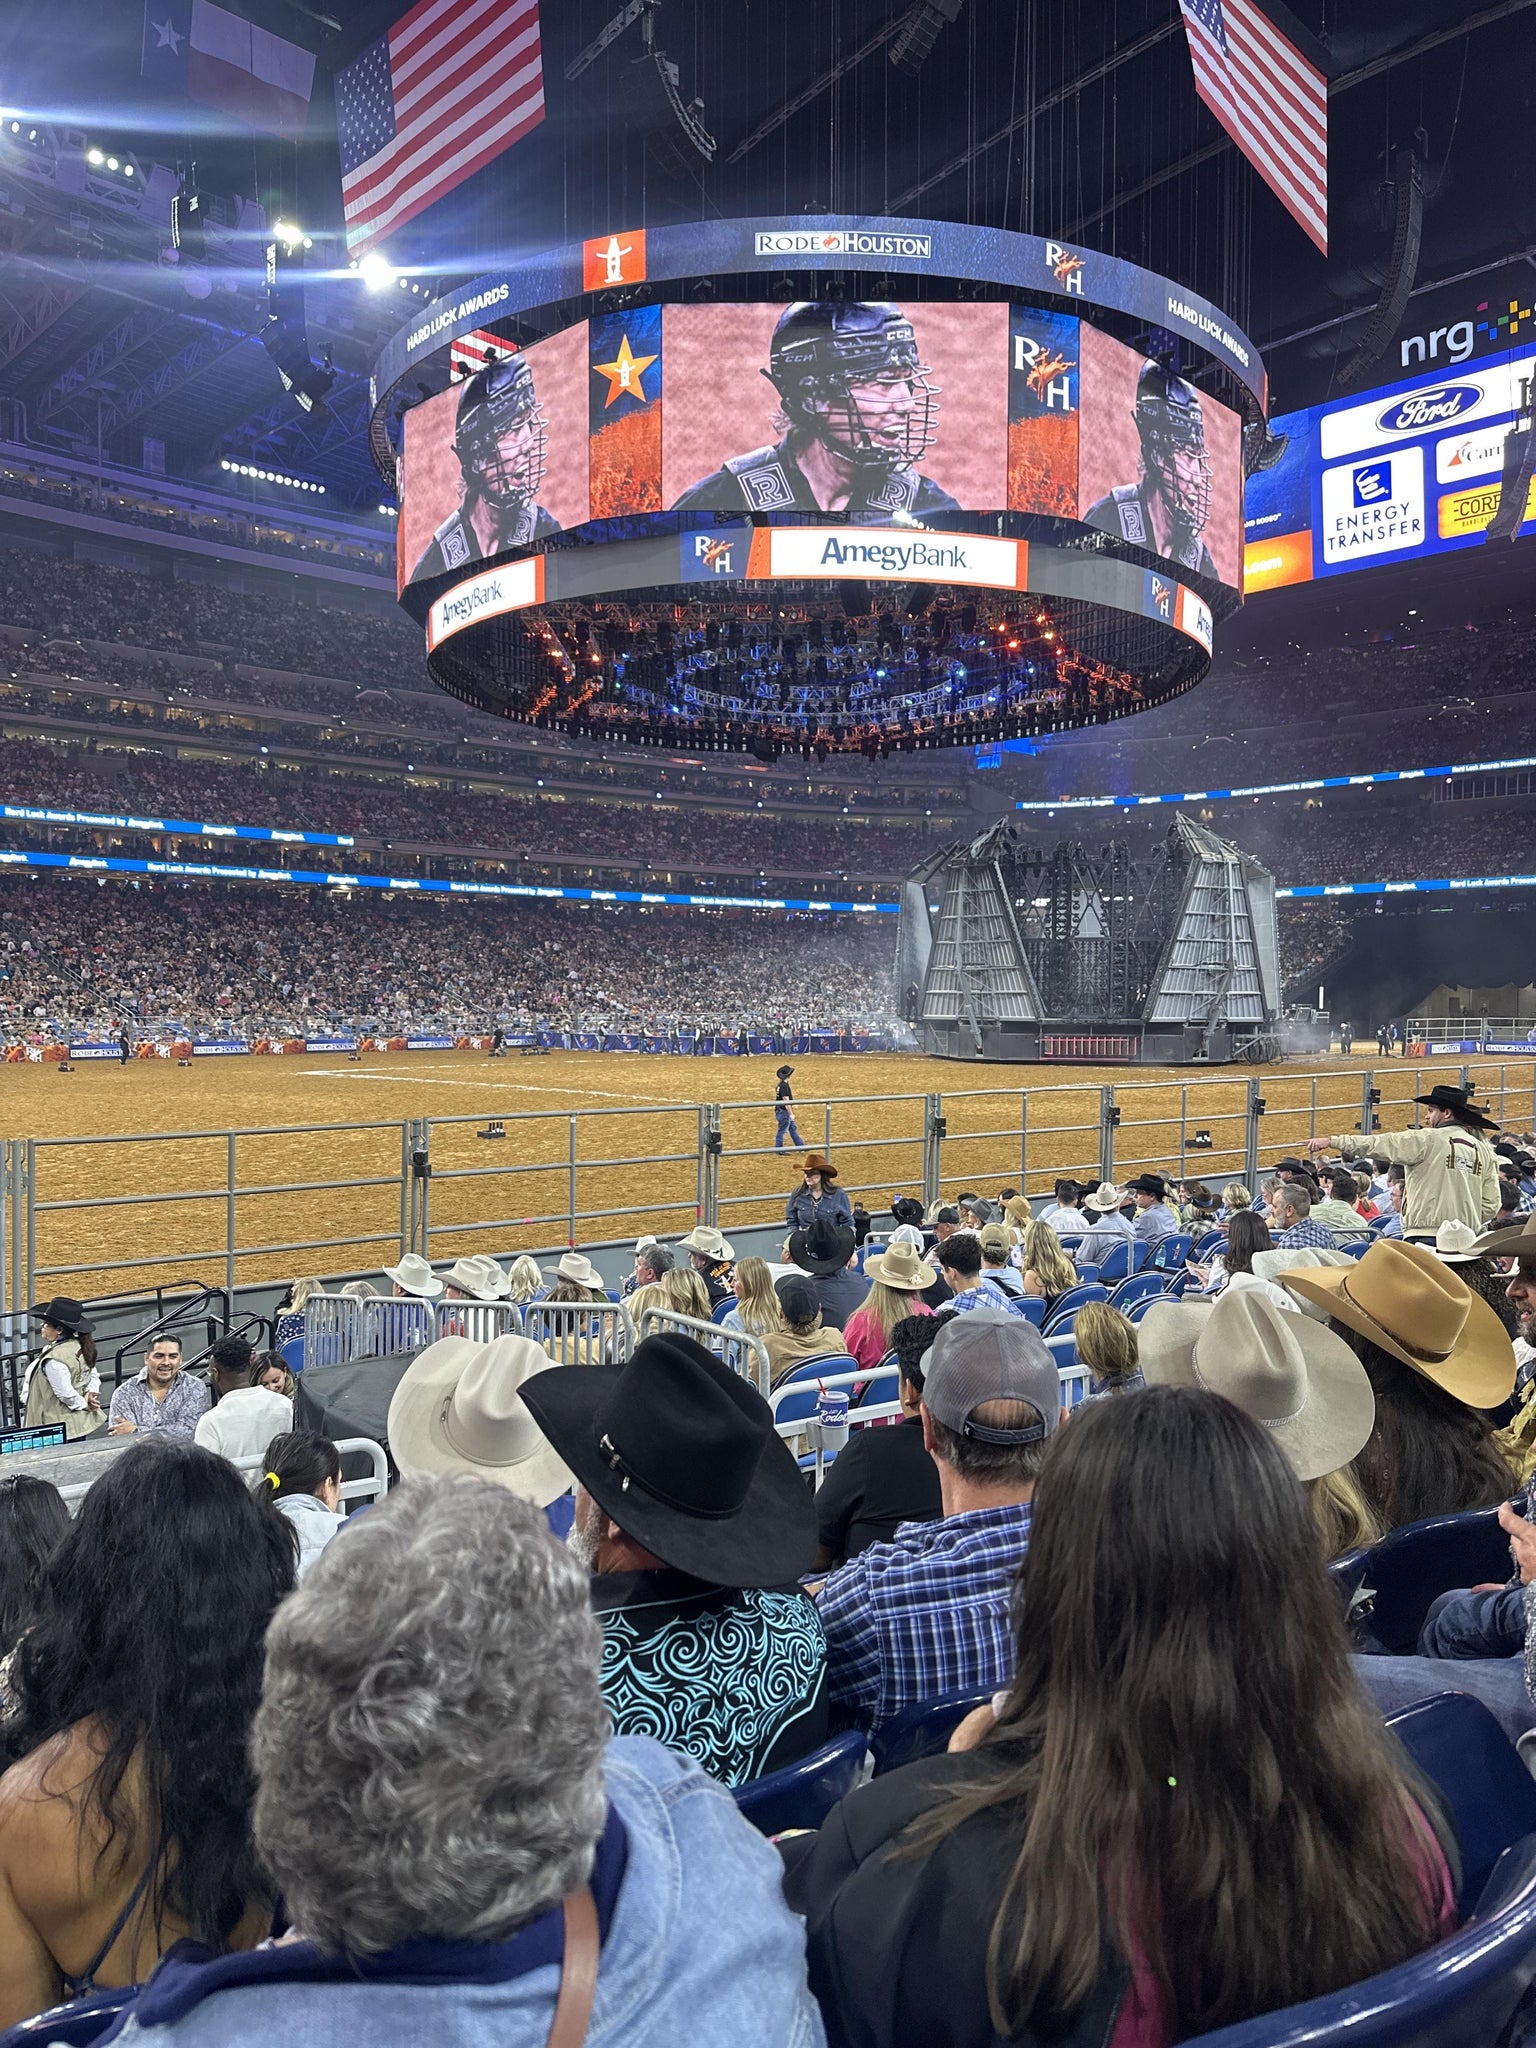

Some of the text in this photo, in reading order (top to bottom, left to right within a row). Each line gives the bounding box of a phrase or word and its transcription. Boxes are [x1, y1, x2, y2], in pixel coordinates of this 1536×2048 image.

[407, 283, 510, 352] HARD LUCK AWARDS
[1168, 297, 1249, 368] HARD LUCK AWARDS
[1401, 321, 1474, 368] nrg
[1396, 391, 1463, 429] Ford
[1328, 518, 1421, 550] TRANSFER
[1336, 502, 1410, 532] ENERGY
[820, 537, 967, 571] AmegyBank
[443, 580, 502, 628] AmegyBank
